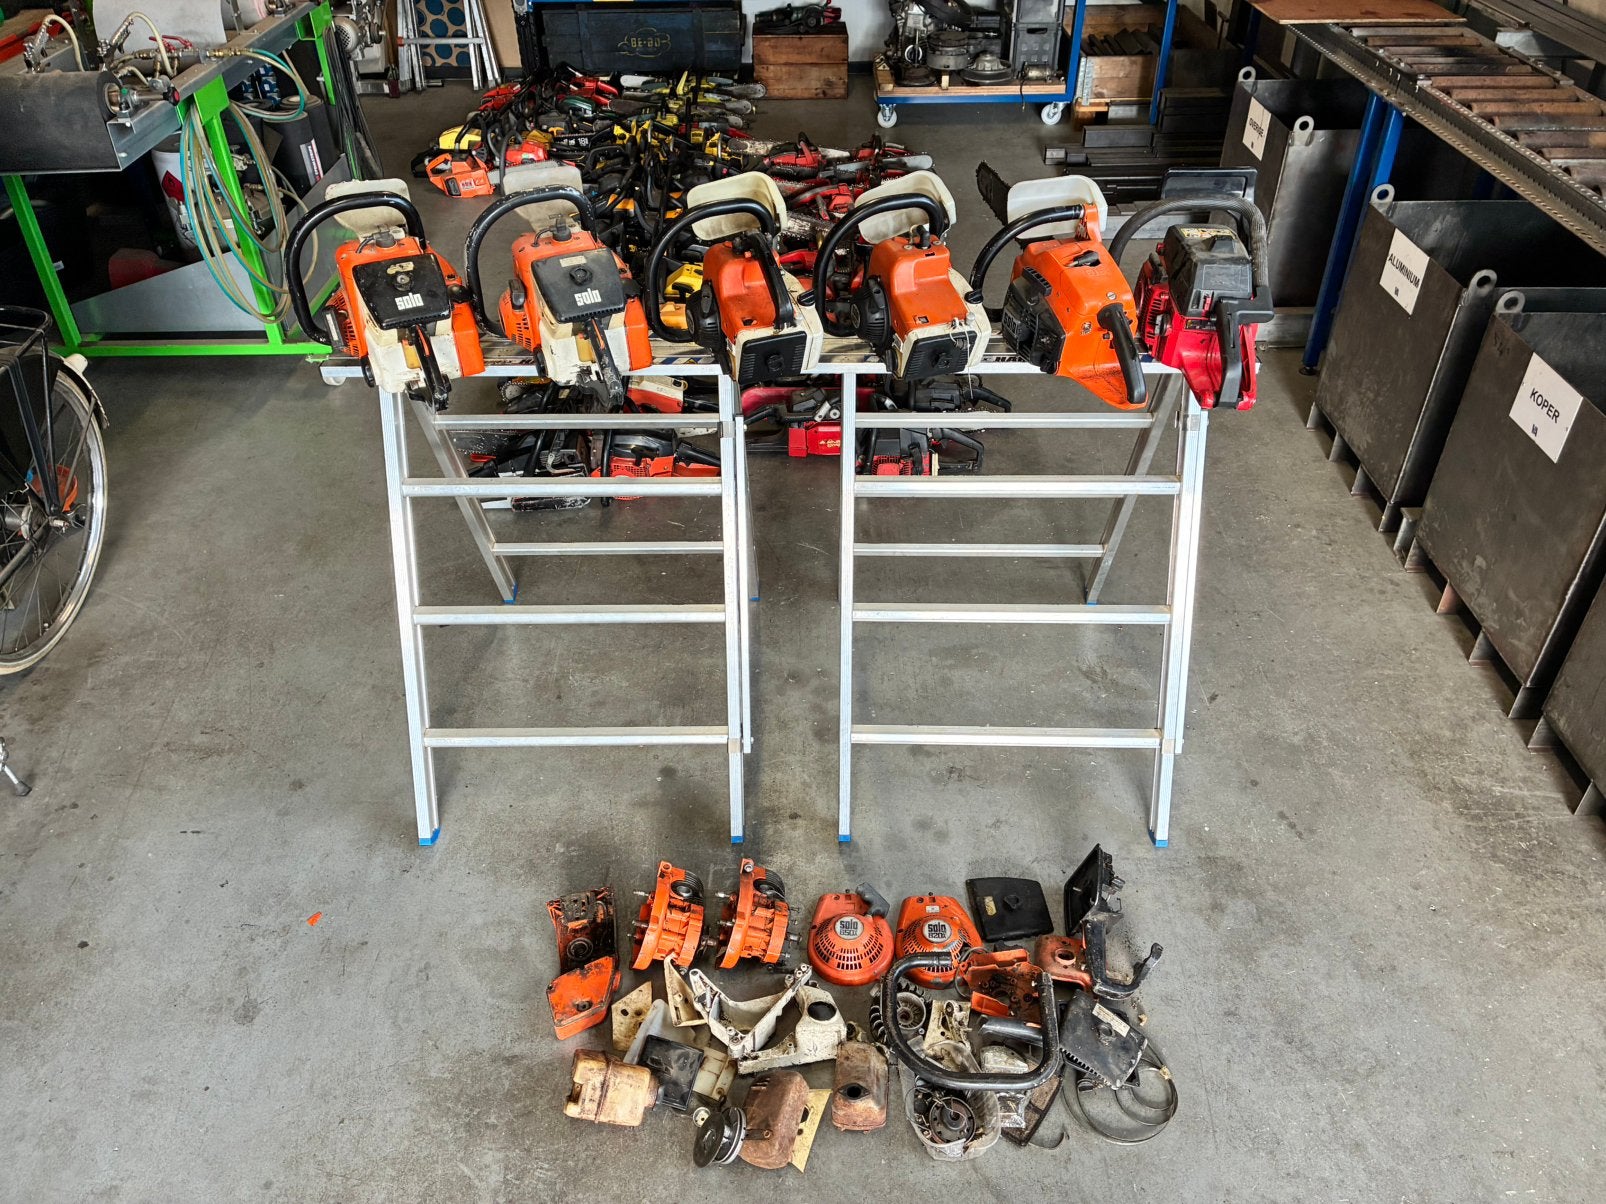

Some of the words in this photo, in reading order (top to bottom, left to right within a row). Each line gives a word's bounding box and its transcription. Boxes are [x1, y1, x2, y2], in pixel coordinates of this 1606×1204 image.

[1388, 253, 1420, 288] ALUMINIUM
[394, 292, 425, 310] solo
[574, 287, 602, 306] solo
[1530, 388, 1560, 424] KOPER
[840, 919, 858, 930] solo
[928, 921, 946, 933] solo
